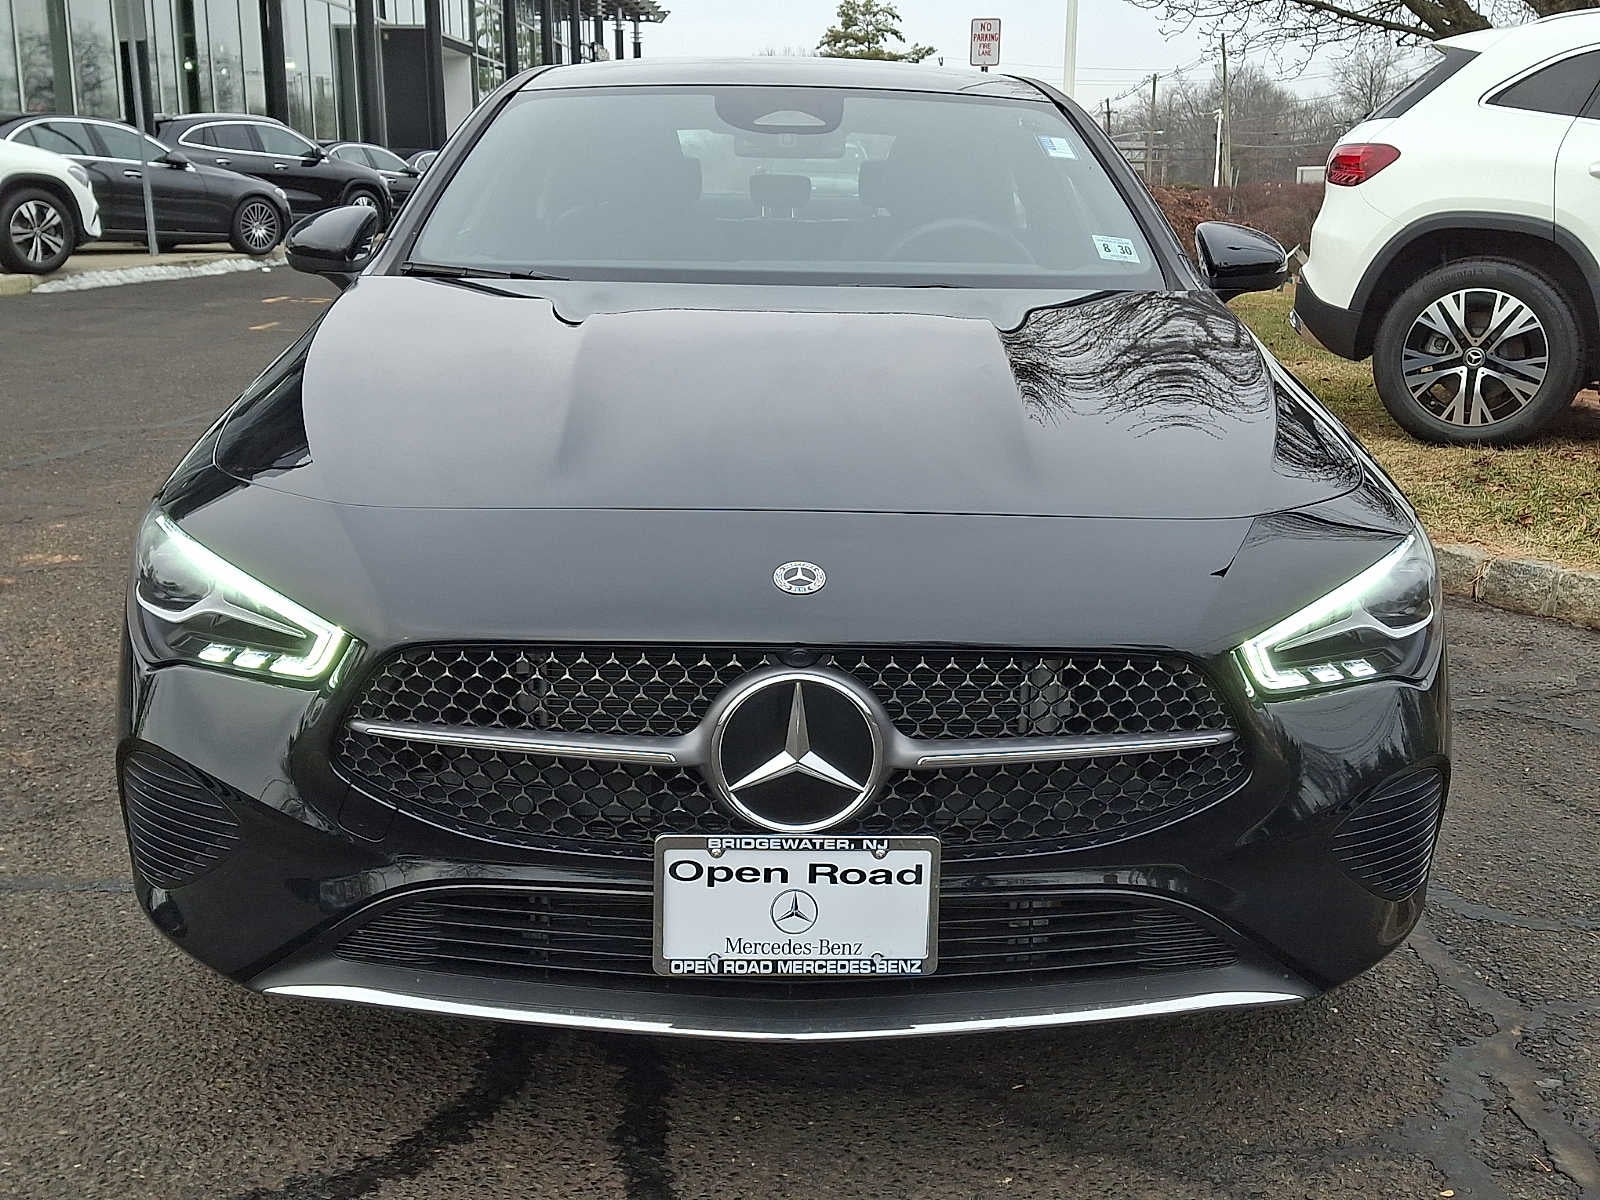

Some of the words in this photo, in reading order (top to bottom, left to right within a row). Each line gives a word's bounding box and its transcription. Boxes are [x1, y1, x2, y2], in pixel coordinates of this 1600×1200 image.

[980, 22, 992, 32] NO
[973, 33, 999, 42] PARKING
[979, 42, 991, 50] FIRE
[1102, 243, 1111, 253] 8
[1117, 245, 1132, 256] 30
[707, 838, 855, 850] BRIDGEWATER,
[862, 838, 889, 850] NJ
[668, 860, 789, 888] Open
[808, 863, 923, 885] Road
[724, 937, 864, 956] Mercedes-Benz
[670, 960, 718, 975] OPEN
[723, 960, 773, 975] ROAD
